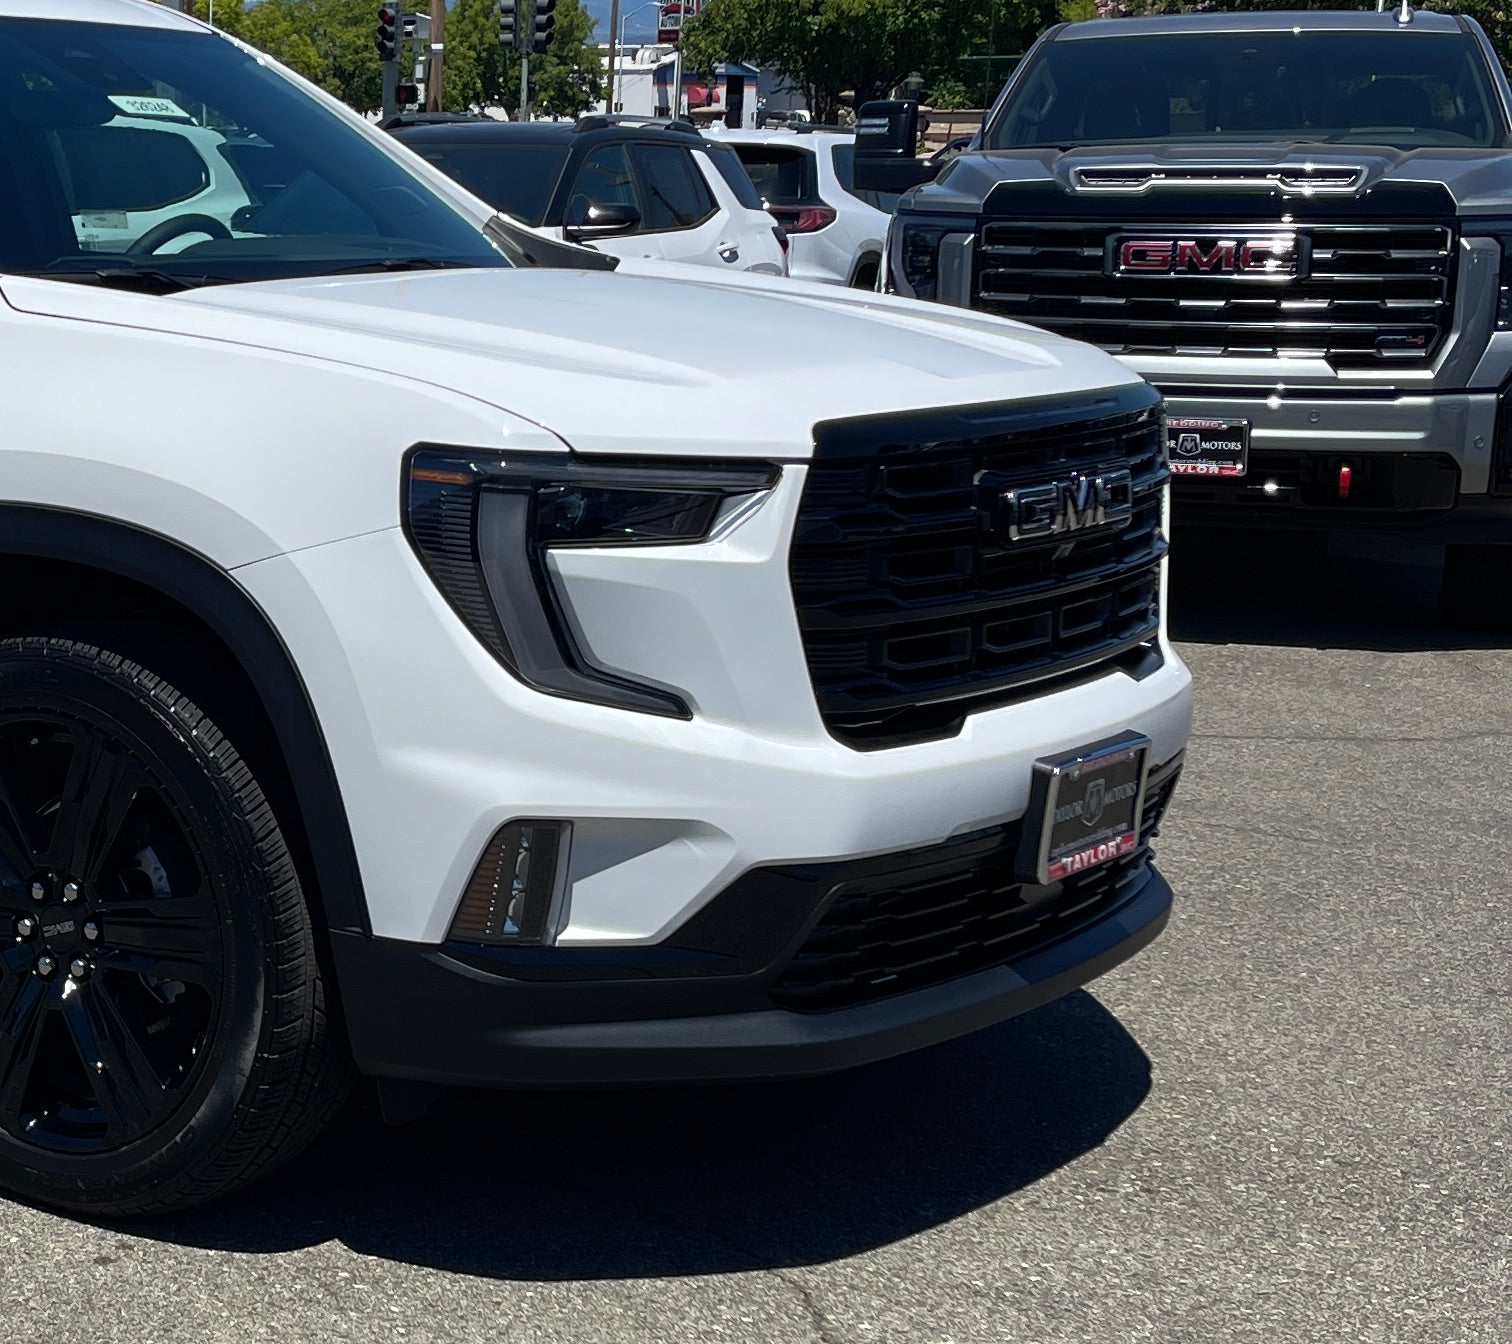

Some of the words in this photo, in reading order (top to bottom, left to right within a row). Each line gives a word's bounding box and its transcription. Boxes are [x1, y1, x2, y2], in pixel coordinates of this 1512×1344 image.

[1121, 240, 1295, 272] GMC
[1201, 441, 1242, 450] MOTORS
[1169, 465, 1219, 474] AYLOR
[1006, 468, 1133, 541] GMC
[1065, 841, 1118, 872] TAYLOR
[42, 920, 75, 938] GMC
